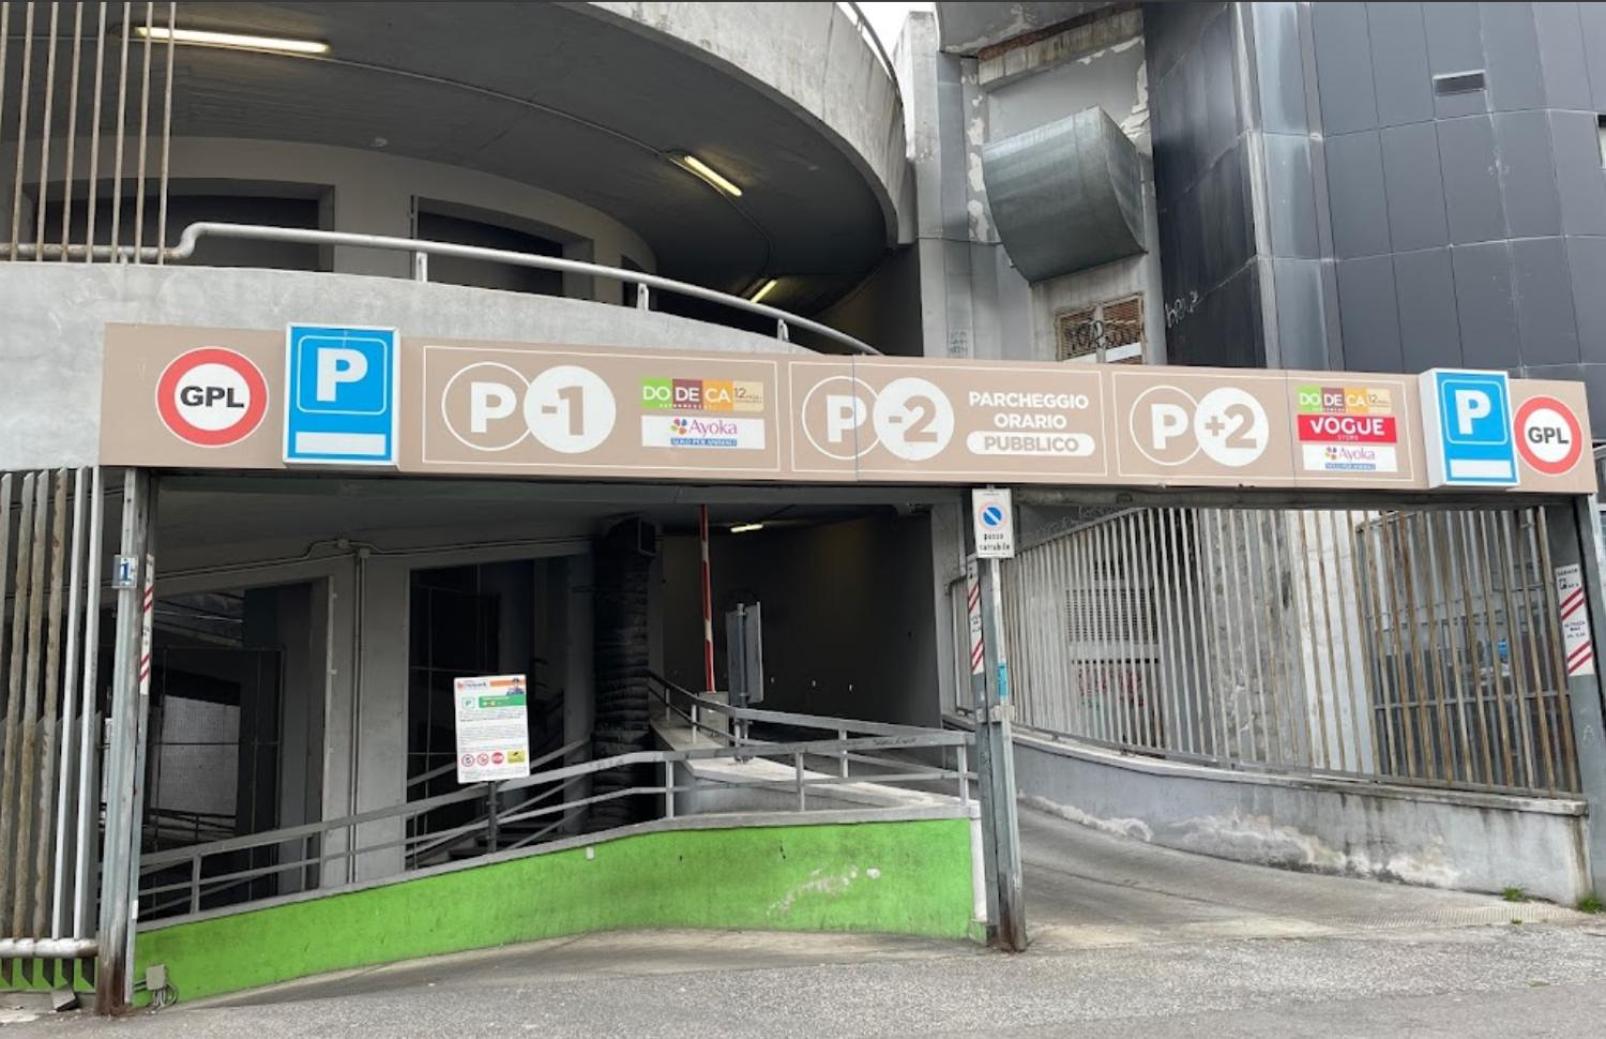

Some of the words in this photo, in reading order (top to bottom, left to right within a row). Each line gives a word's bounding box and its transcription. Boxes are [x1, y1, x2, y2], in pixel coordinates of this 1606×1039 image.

[316, 346, 369, 403] P
[180, 385, 245, 408] GPL
[968, 390, 1089, 410] PARCHEGGIO
[470, 381, 517, 434] P
[541, 385, 585, 437] -1
[825, 394, 868, 444] P
[888, 393, 938, 444] -2
[1454, 389, 1492, 435] P
[688, 418, 738, 437] Ayoka
[993, 412, 1067, 430] ORARIO
[1150, 403, 1189, 450] P
[1204, 402, 1258, 449] +2
[1310, 416, 1385, 436] VOGUE
[983, 434, 1080, 453] PUBBLICO
[1528, 426, 1569, 444] GPL
[1338, 447, 1376, 461] Ayoka
[119, 561, 131, 581] 1
